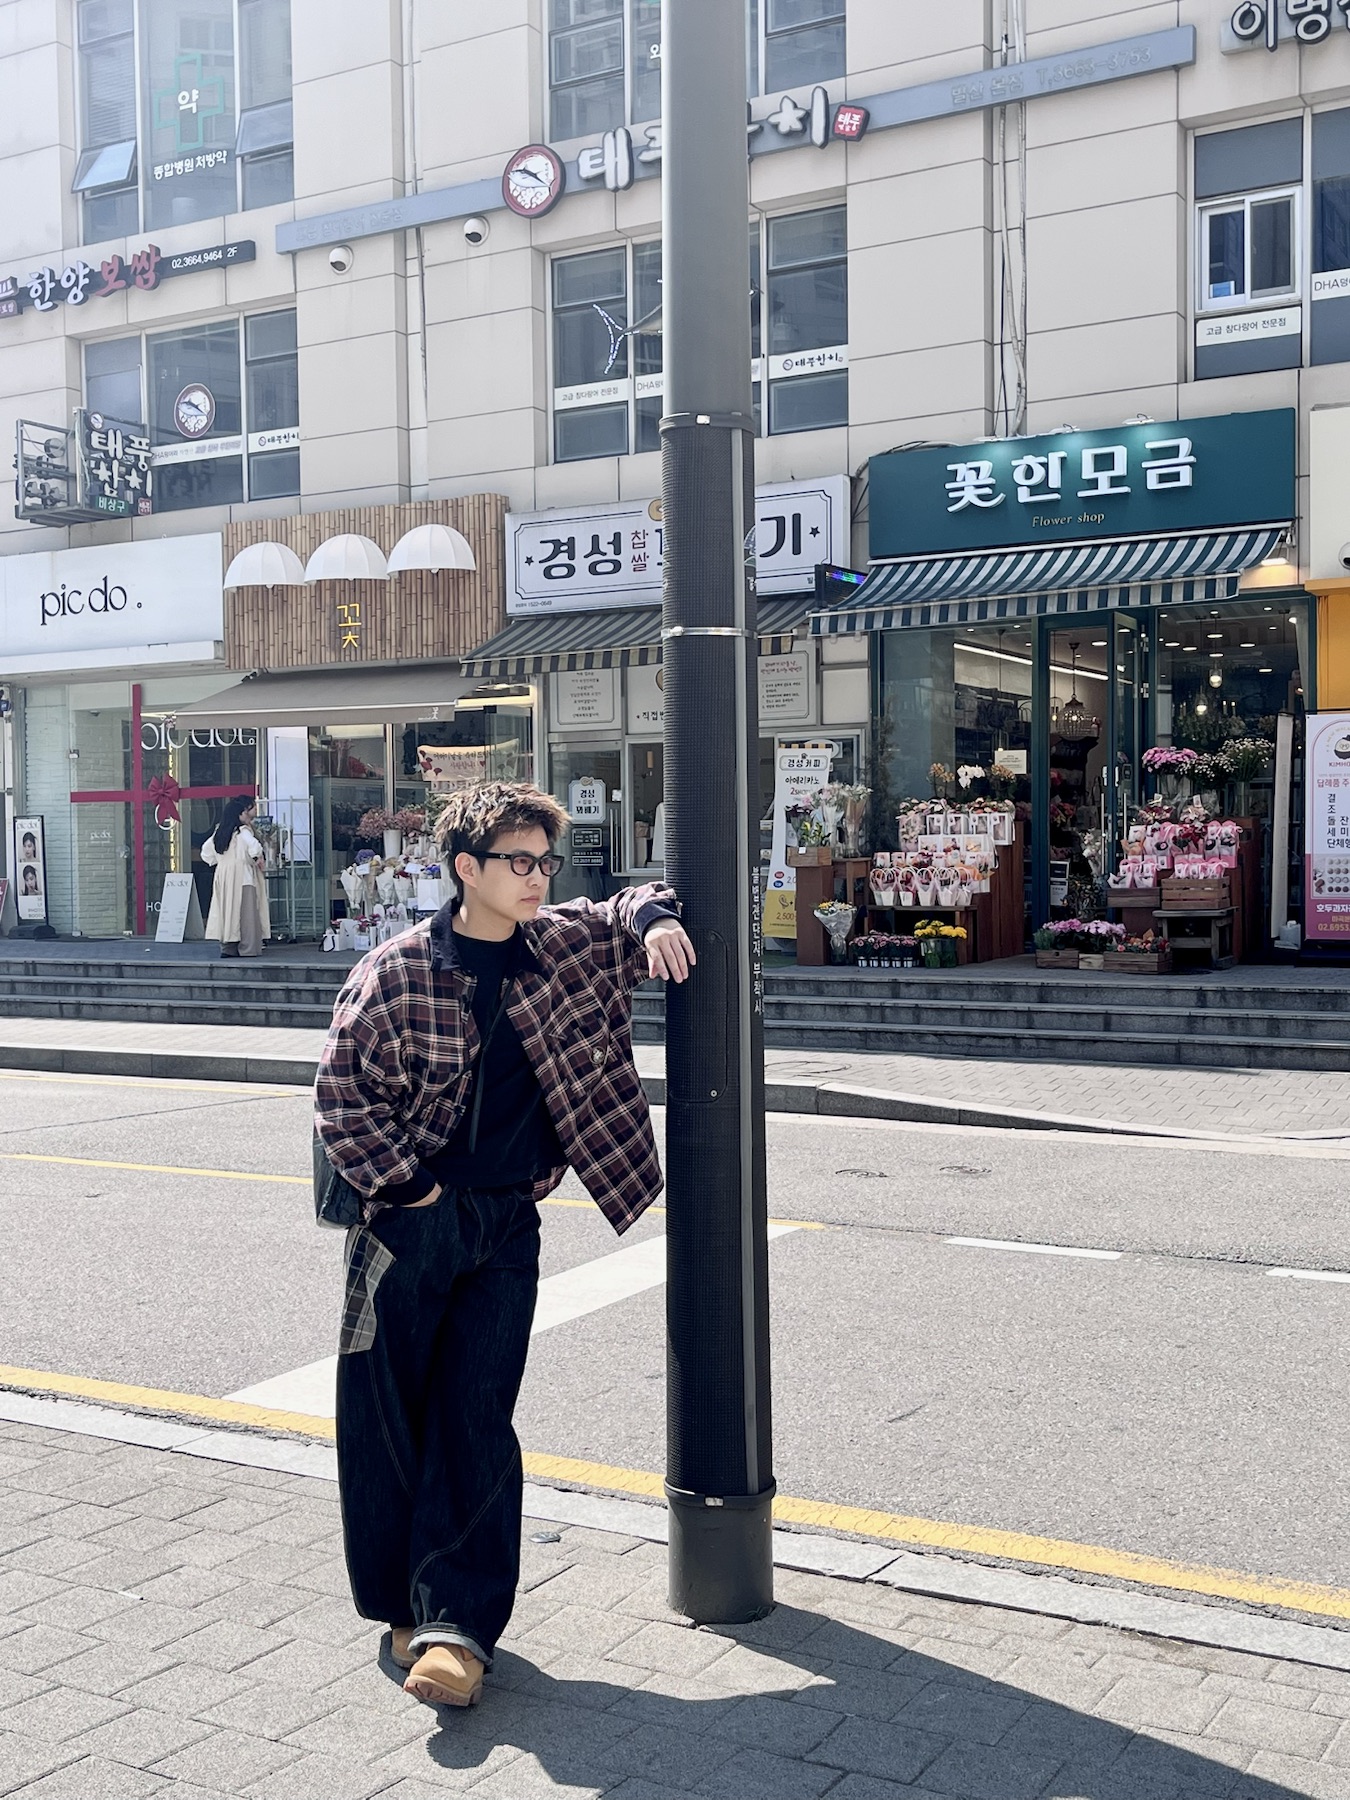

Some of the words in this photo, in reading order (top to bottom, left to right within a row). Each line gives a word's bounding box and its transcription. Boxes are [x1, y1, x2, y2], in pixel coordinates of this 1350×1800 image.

[1231, 0, 1350, 52] 이병
[177, 88, 200, 114] 약
[154, 157, 194, 180] 종합병원
[195, 150, 227, 169] 처방약
[26, 243, 161, 311] 한양보쌈
[171, 249, 223, 269] 02.3664.9464
[226, 246, 238, 258] 2F
[1206, 325, 1223, 336] 고급
[1261, 316, 1287, 330] 전문점
[944, 437, 1197, 513] 꽃한모금
[98, 496, 126, 513] 비상구
[1032, 516, 1073, 528] Flower
[1077, 511, 1105, 525] shop
[538, 531, 622, 580] 경성
[631, 529, 649, 572] 찹쌀
[40, 583, 85, 626] pic
[337, 603, 362, 649] 꽃
[787, 758, 821, 768] 경성커피
[1327, 804, 1337, 814] 조
[1327, 827, 1336, 837] 세
[1340, 827, 1350, 837] 미
